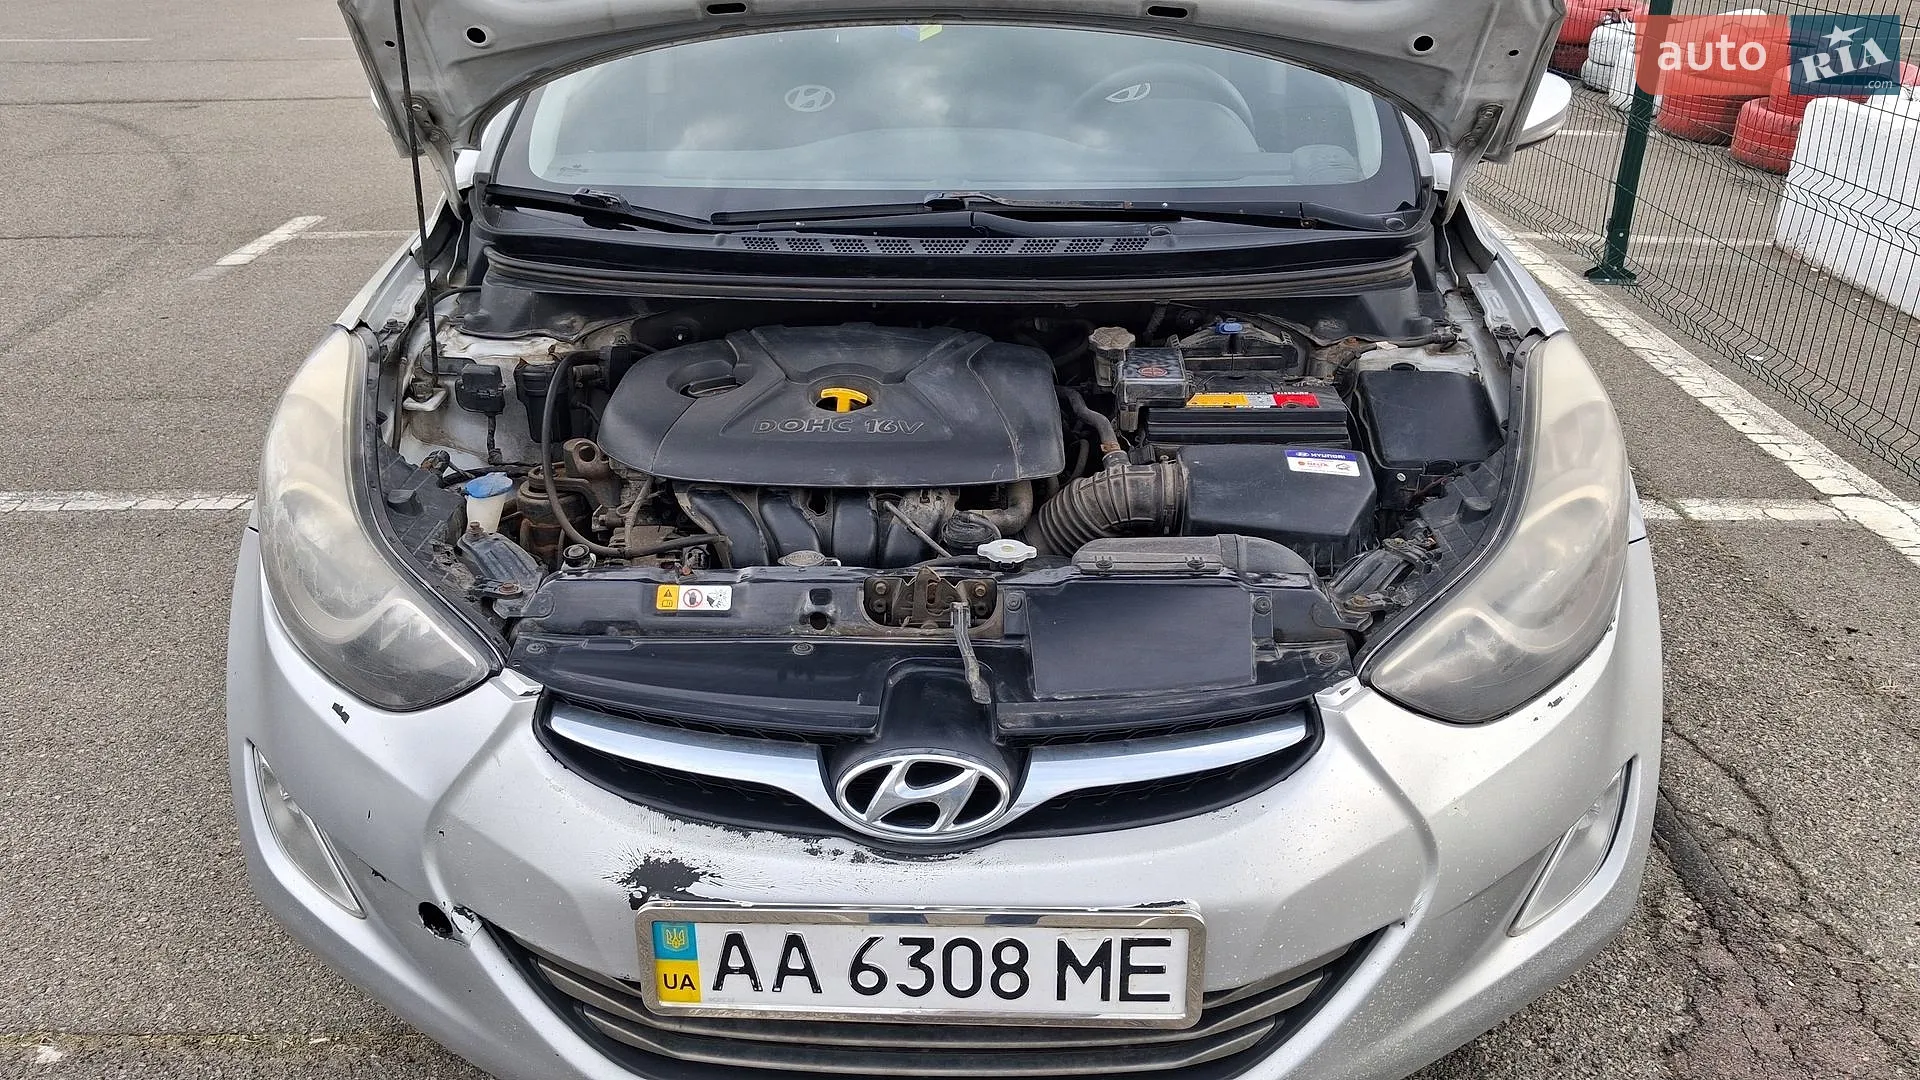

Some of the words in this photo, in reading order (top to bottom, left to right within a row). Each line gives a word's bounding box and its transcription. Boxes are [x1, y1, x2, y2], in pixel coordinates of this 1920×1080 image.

[752, 417, 855, 434] DOHC
[864, 418, 925, 434] 16V
[712, 931, 823, 993] AA
[848, 936, 1030, 1000] 6308
[1055, 936, 1172, 1002] ME
[663, 973, 696, 991] UA
